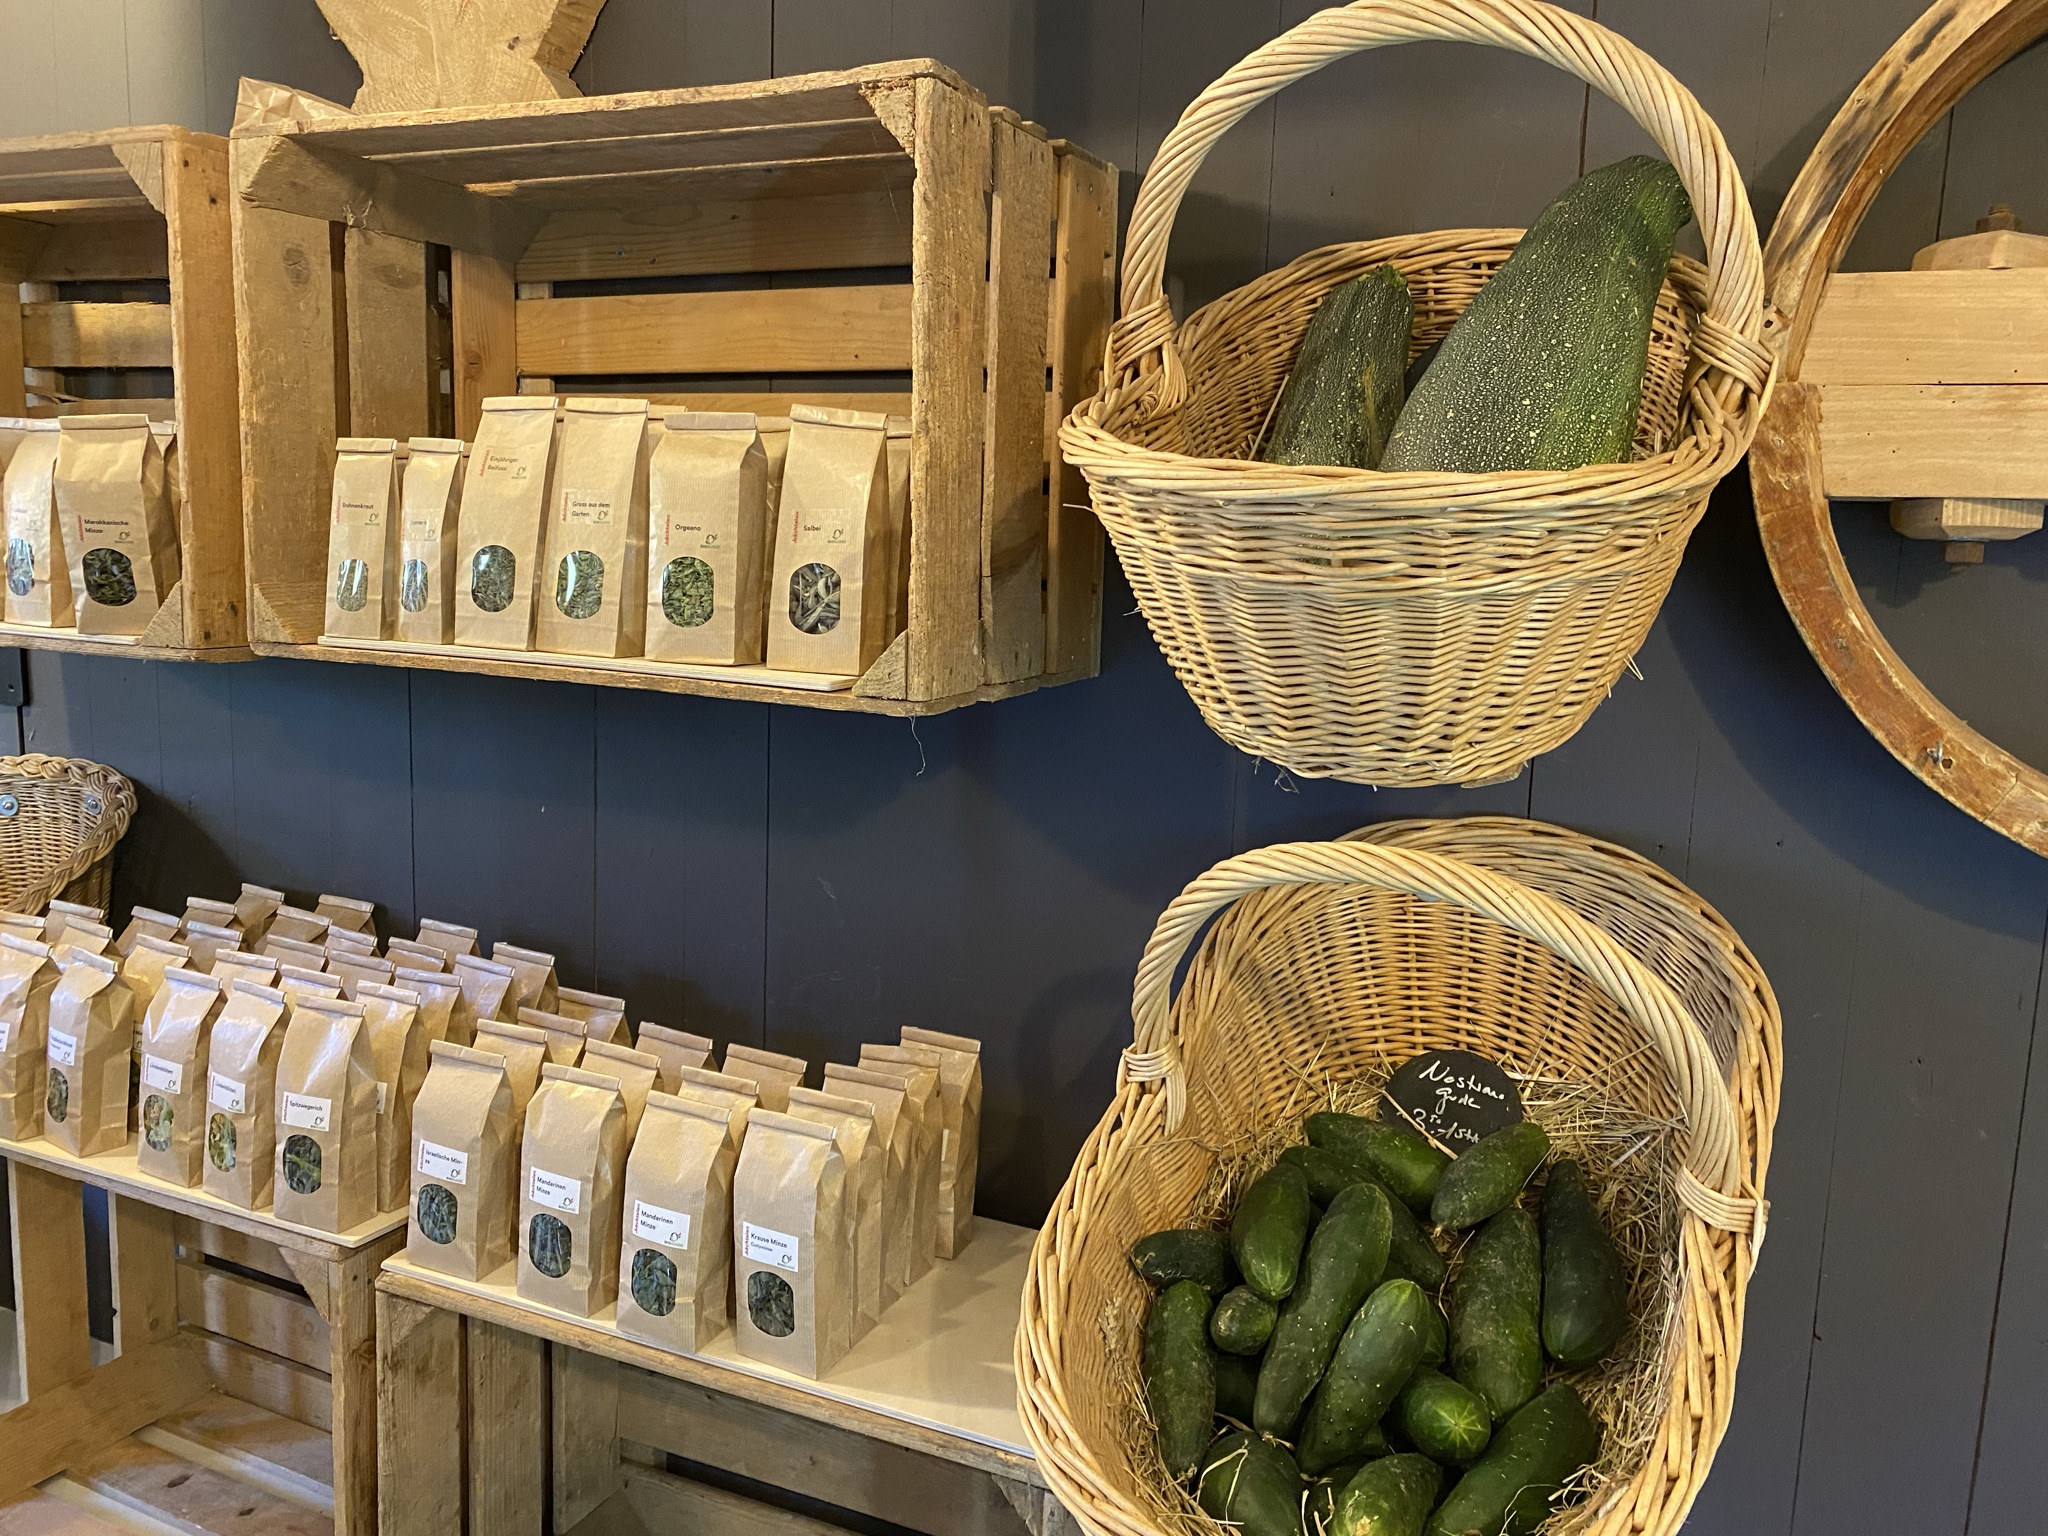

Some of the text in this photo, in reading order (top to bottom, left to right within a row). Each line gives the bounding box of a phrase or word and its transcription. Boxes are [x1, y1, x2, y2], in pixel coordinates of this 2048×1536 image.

[487, 464, 507, 472] Beifuss
[675, 524, 702, 532] Orgeano
[289, 1100, 323, 1112] Spitzwegerich
[426, 1149, 450, 1162] Israelische
[536, 1176, 567, 1191] Mandarinen
[536, 1185, 551, 1196] Minze
[641, 1210, 674, 1225] Mandarinen
[640, 1219, 656, 1231] Minze
[750, 1232, 788, 1249] Krause Minze
